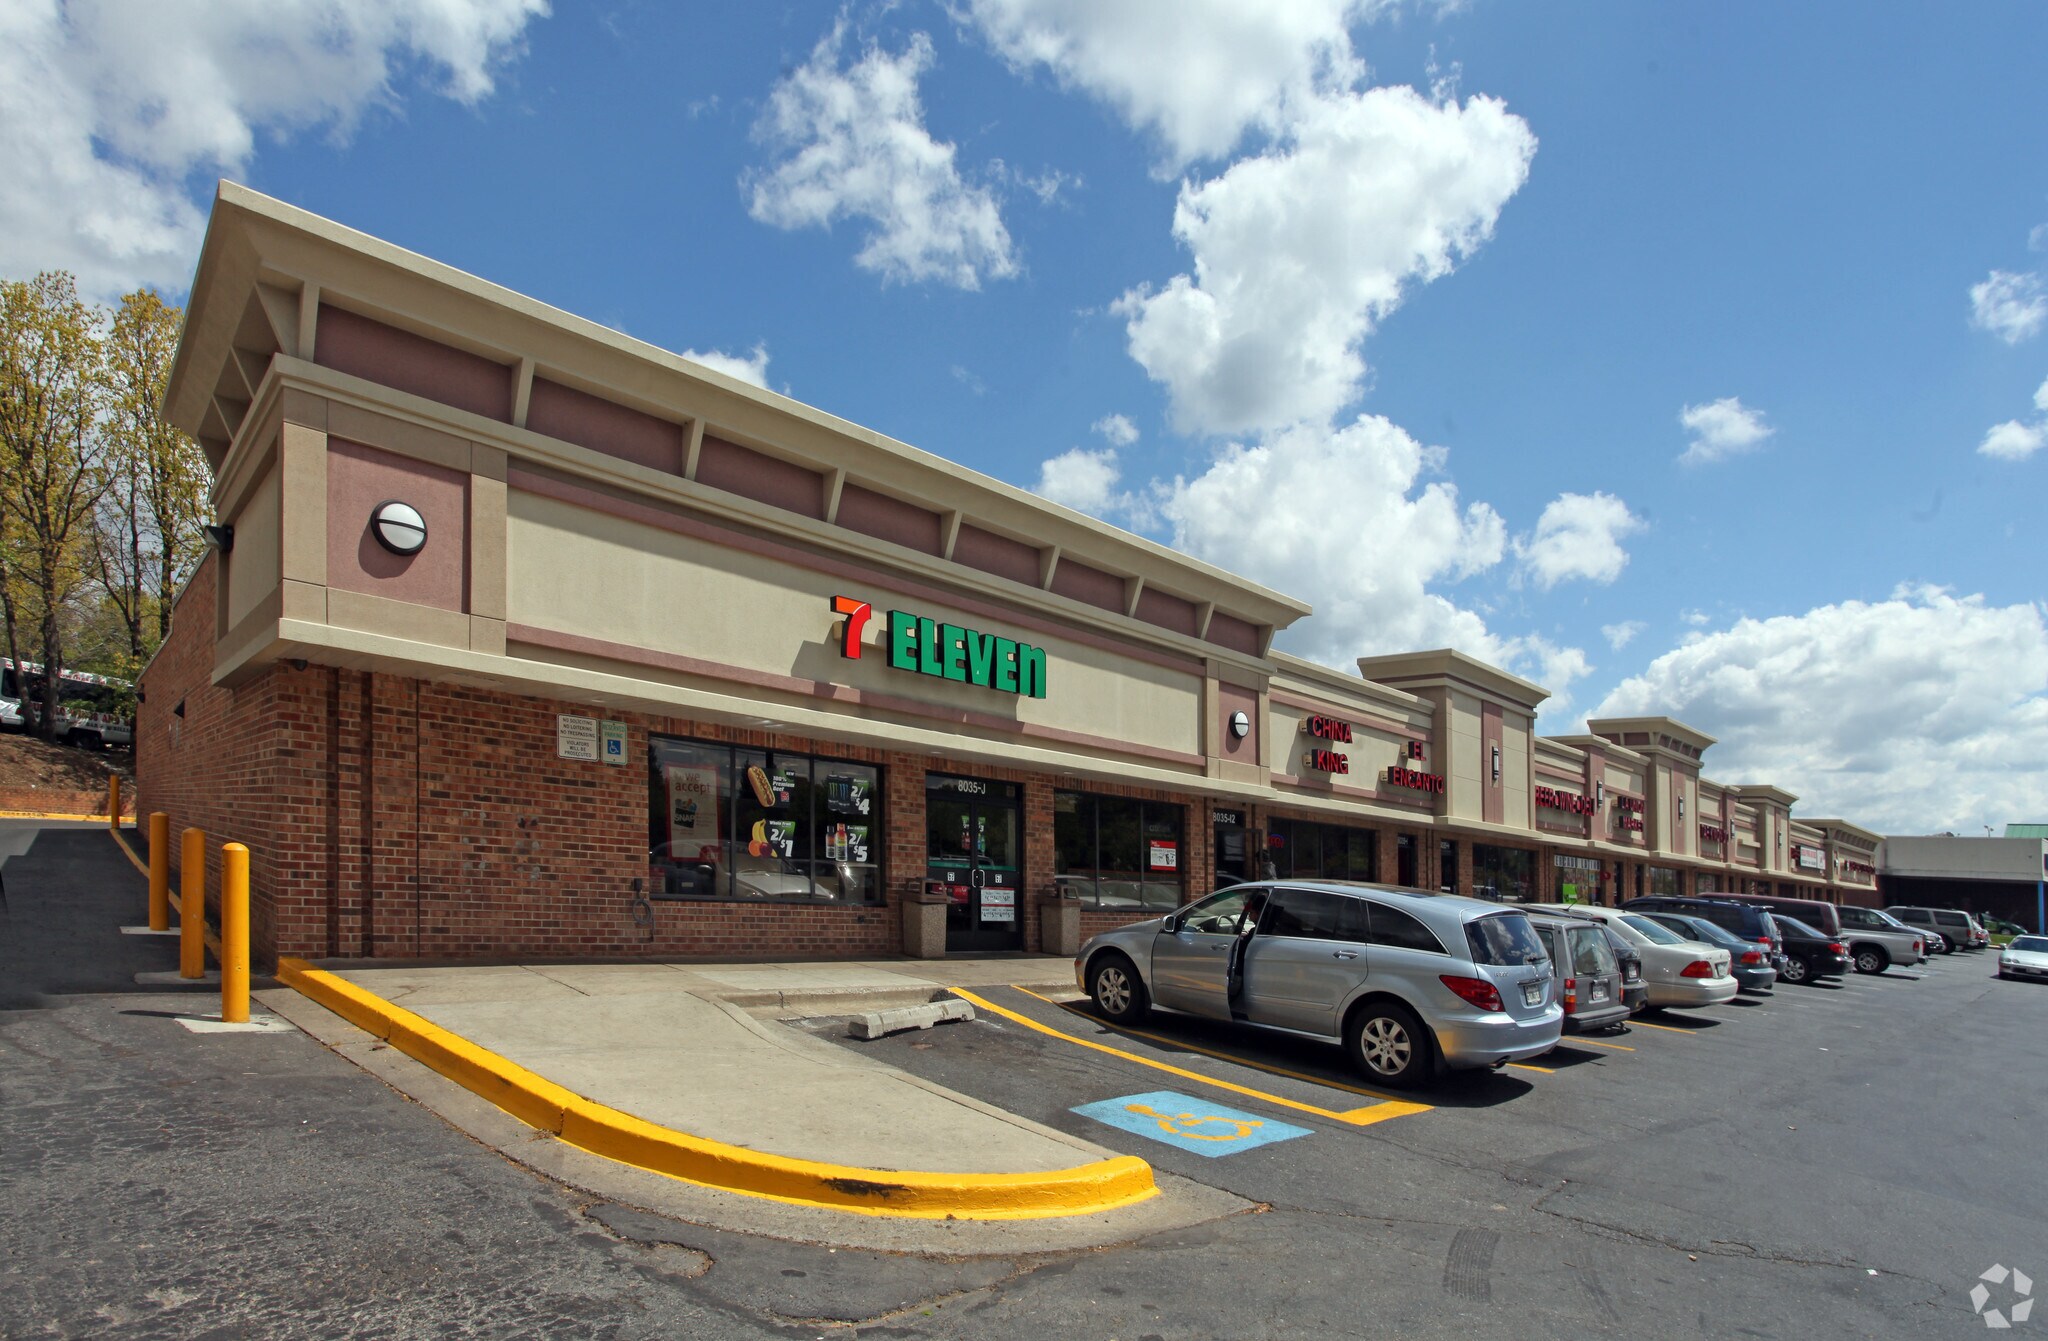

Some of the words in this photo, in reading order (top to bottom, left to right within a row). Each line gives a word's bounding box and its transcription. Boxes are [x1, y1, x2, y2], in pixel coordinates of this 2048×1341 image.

[831, 595, 871, 659] 7
[568, 730, 595, 738] TRESPASSING
[1312, 715, 1353, 744] CHINA
[564, 750, 592, 758] PROSECUTED
[1317, 749, 1349, 774] KING
[1413, 741, 1427, 762] EL
[675, 782, 711, 795] accept
[958, 780, 986, 794] 8035-J
[1392, 766, 1444, 794] ENCANTO
[1535, 785, 1554, 808] BEER
[674, 813, 695, 822] SNAP
